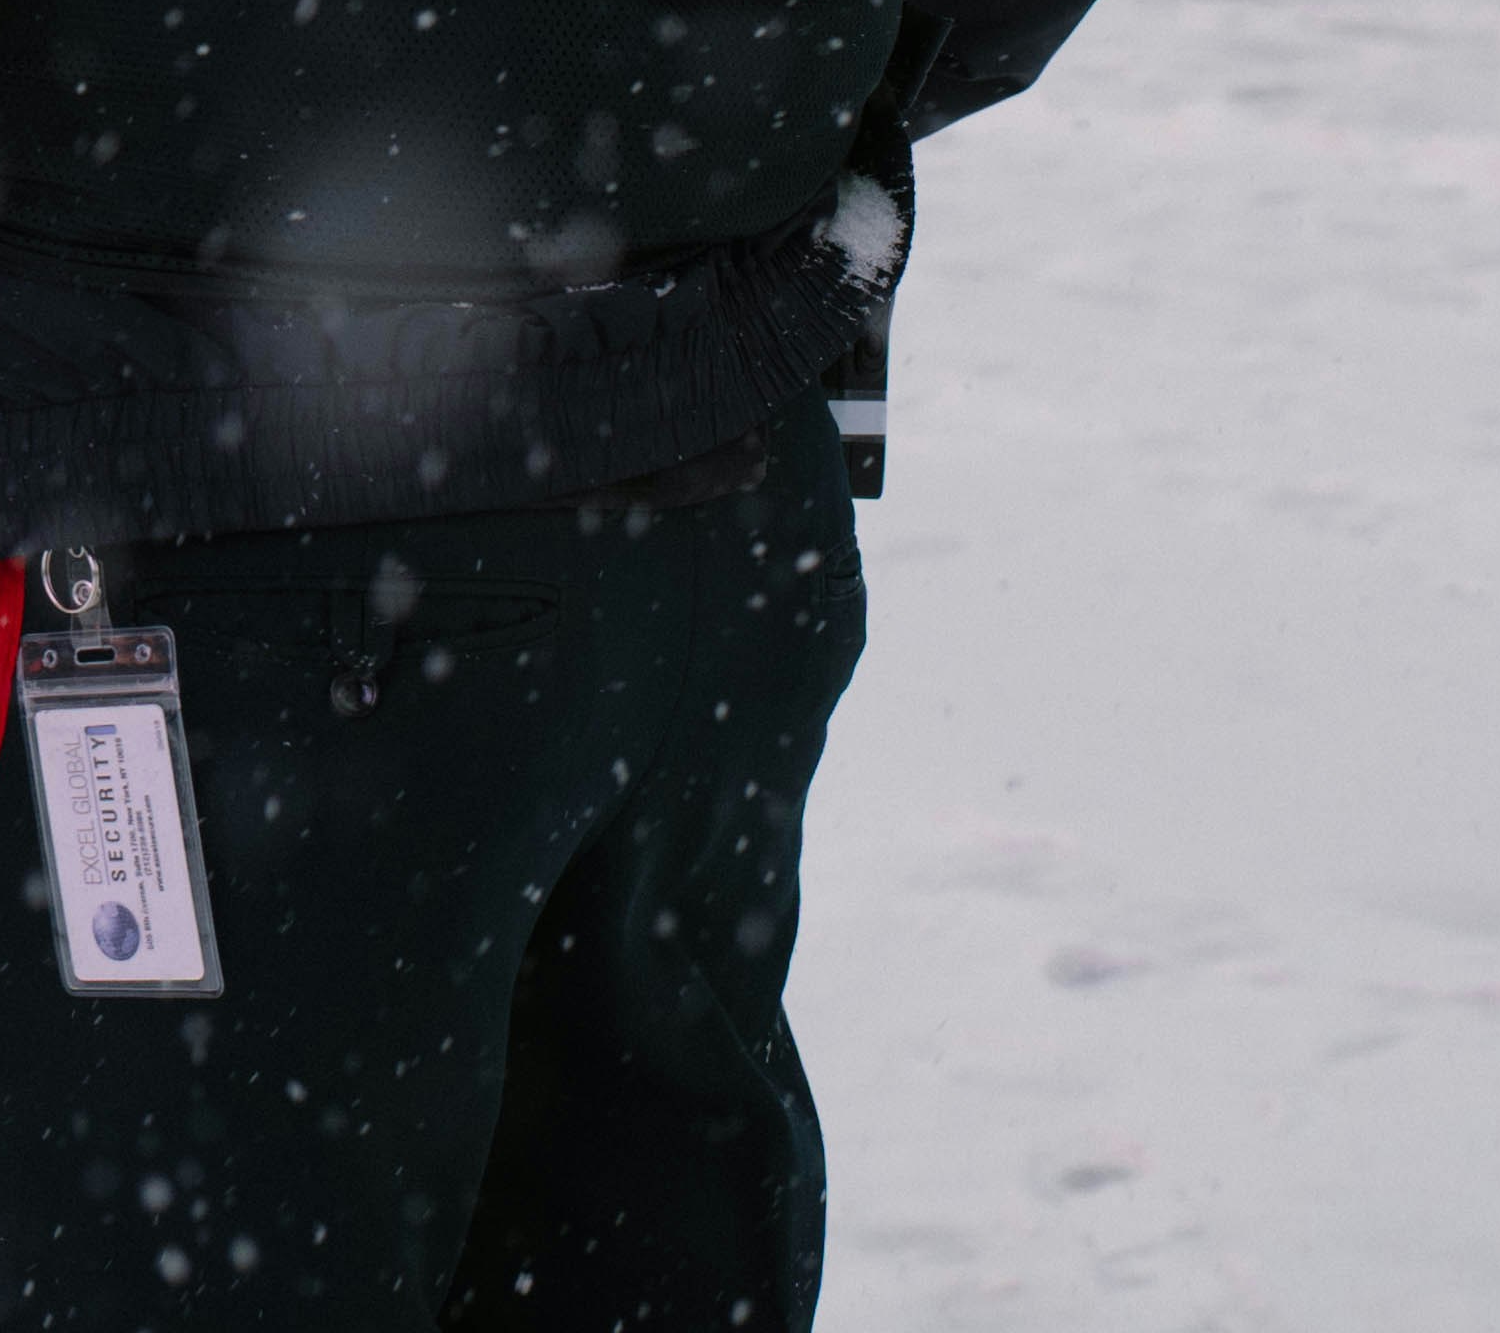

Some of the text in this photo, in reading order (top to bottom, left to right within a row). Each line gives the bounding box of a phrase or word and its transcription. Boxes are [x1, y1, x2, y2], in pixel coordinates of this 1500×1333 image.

[65, 734, 104, 886] EXCEL GLOBAL
[93, 737, 127, 883] SECURITY
